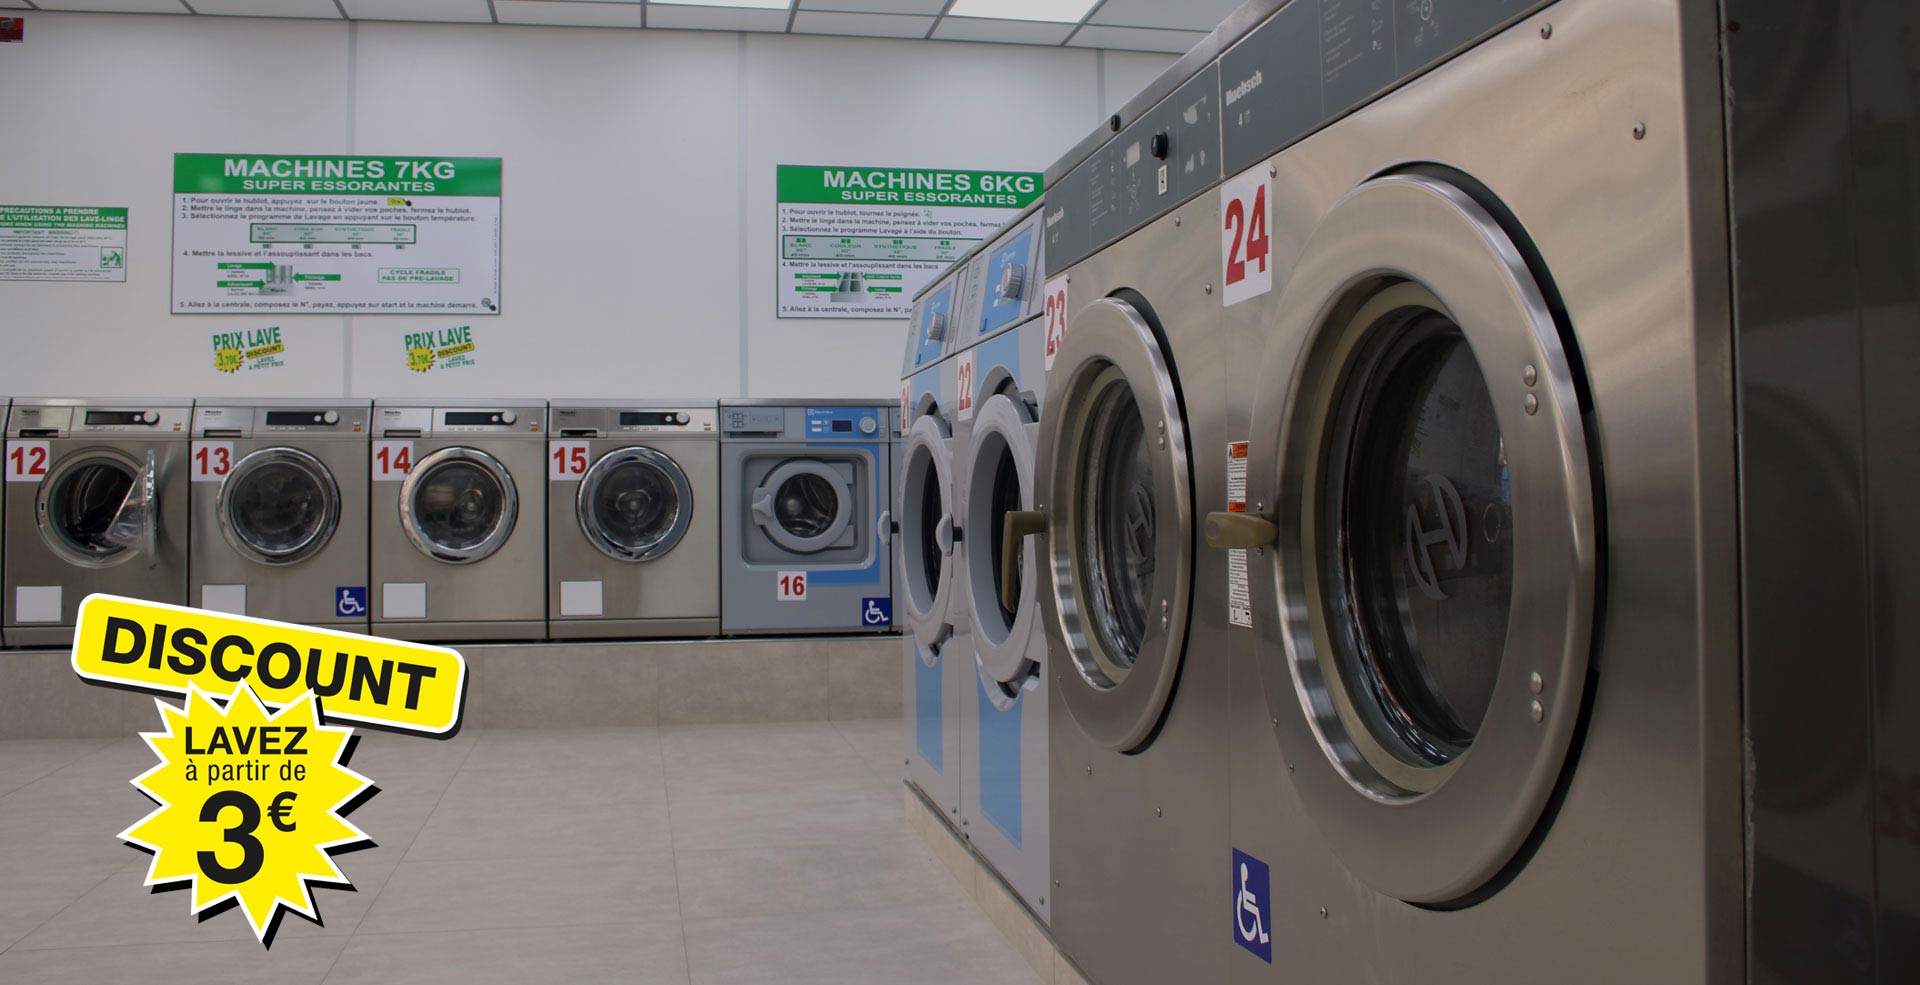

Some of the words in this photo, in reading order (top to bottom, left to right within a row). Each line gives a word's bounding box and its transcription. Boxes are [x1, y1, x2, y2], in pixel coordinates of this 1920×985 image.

[1226, 70, 1262, 106] Huebsch
[224, 159, 385, 179] MACHINES
[395, 161, 456, 179] 7KG
[823, 170, 970, 191] MACHINES
[980, 176, 1035, 193] 6KG
[243, 180, 305, 190] SUPER
[311, 181, 435, 191] ESSORANTES
[841, 190, 899, 201] SUPER
[904, 192, 1017, 204] ESSORANTES
[1225, 183, 1269, 286] 24
[1046, 290, 1066, 356] 23
[212, 331, 244, 351] PRIX
[247, 326, 281, 347] LAVE
[404, 331, 435, 350] PRIX
[438, 325, 472, 347] LAVE
[437, 343, 473, 357] DISCOUNT
[246, 343, 283, 358] DISCOUNT
[958, 362, 972, 411] 22
[11, 447, 47, 475] 12
[195, 447, 231, 475] 13
[376, 447, 411, 474] 14
[553, 446, 587, 474] 15
[780, 575, 805, 596] 16
